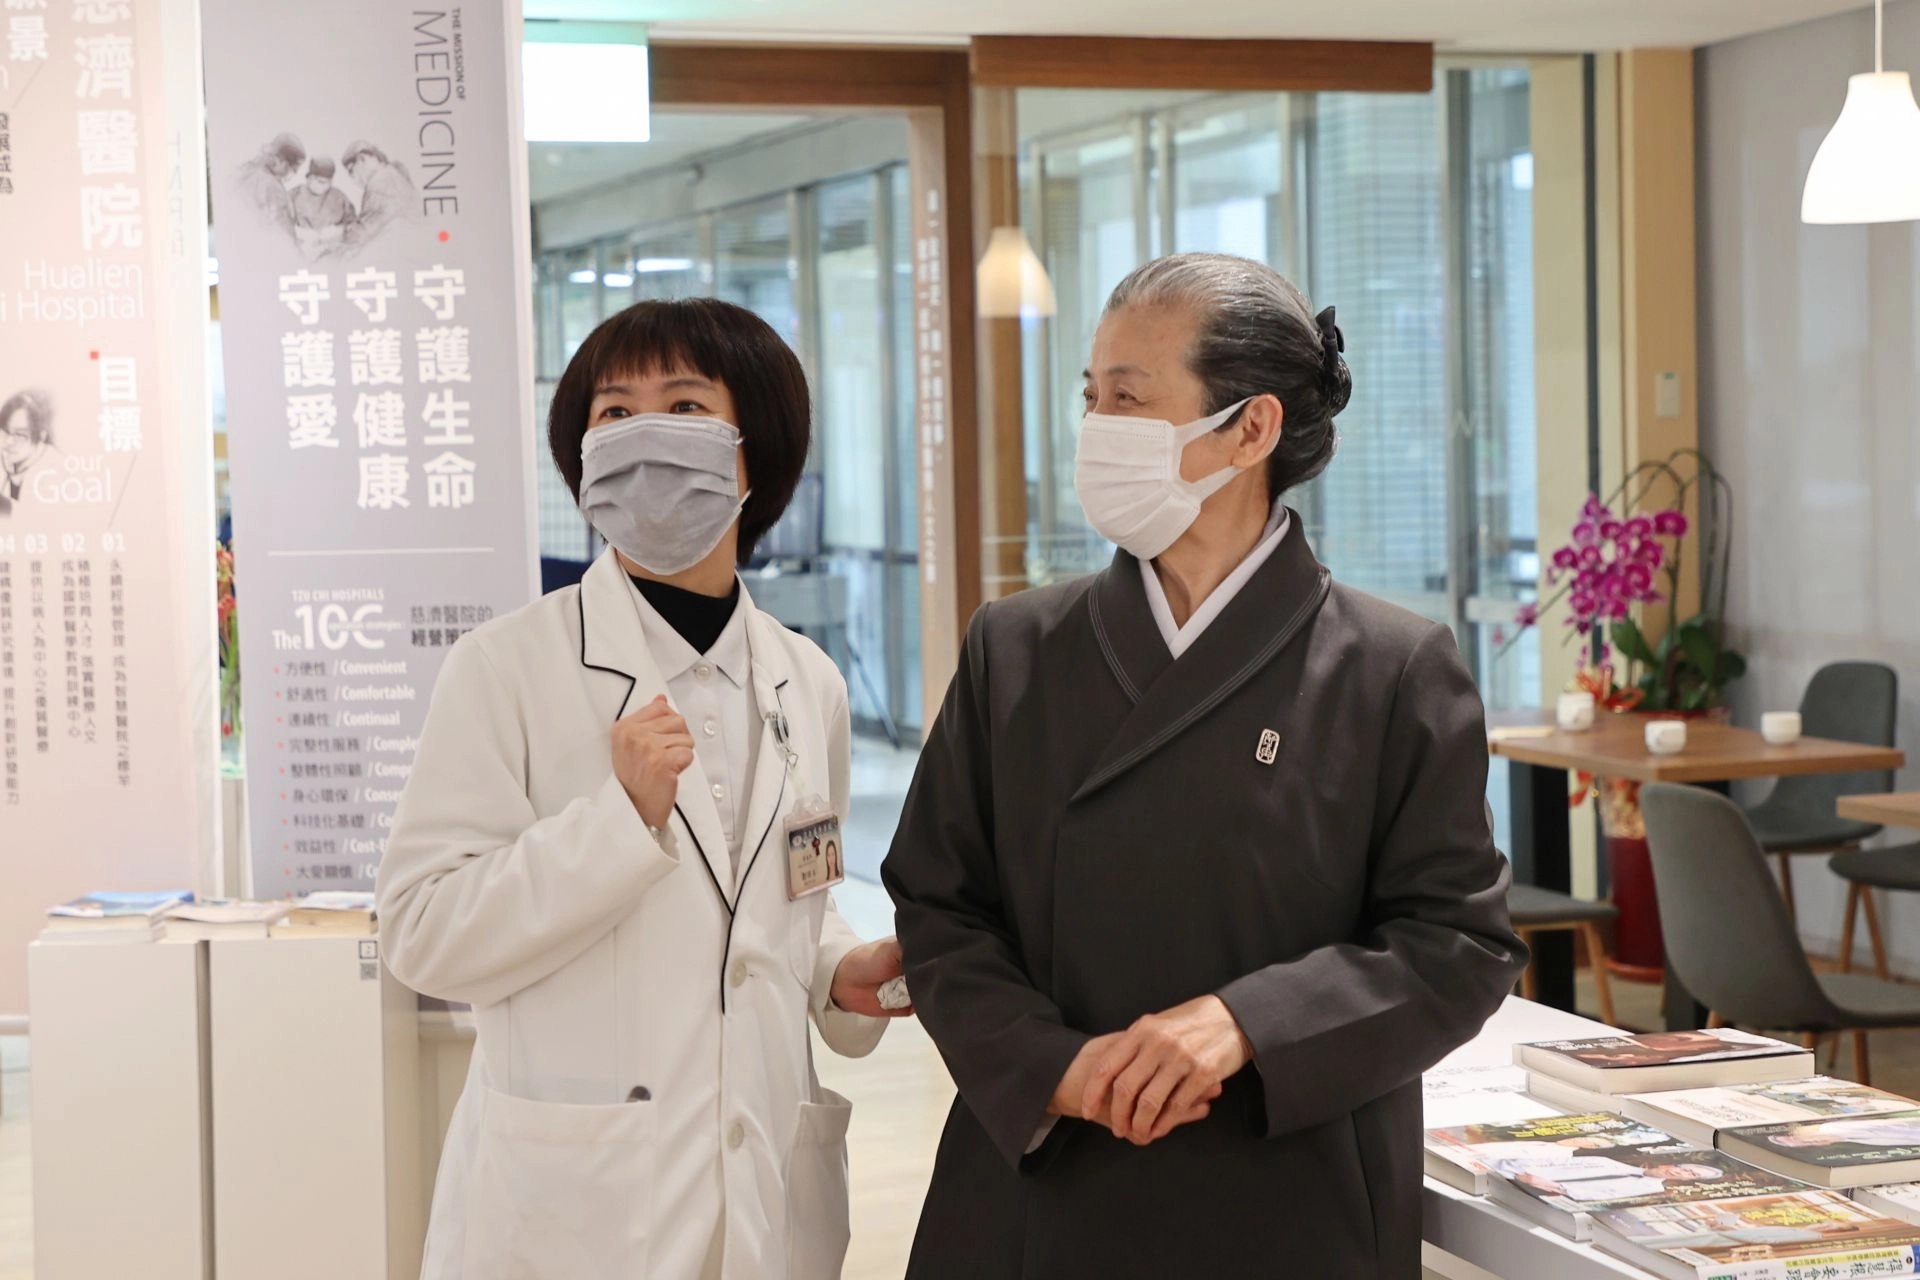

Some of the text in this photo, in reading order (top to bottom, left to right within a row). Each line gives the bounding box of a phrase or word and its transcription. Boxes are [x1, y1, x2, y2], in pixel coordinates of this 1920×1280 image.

[4, 0, 49, 61] 景
[452, 8, 466, 100] THE MISSION OF
[413, 10, 459, 216] MEDICINE
[24, 257, 143, 290] Hualien
[17, 290, 145, 327] Hospital
[278, 269, 340, 450] 守護愛
[98, 356, 143, 452] 目標
[345, 266, 411, 510] 守護健康
[413, 264, 476, 508] 守護生命
[64, 454, 102, 473] our
[33, 467, 112, 504] Goal
[24, 533, 49, 553] 03
[61, 533, 86, 553] 02
[102, 532, 126, 552] 01
[271, 628, 302, 650] The
[411, 628, 475, 648] 經營策
[285, 662, 326, 677] 方便性
